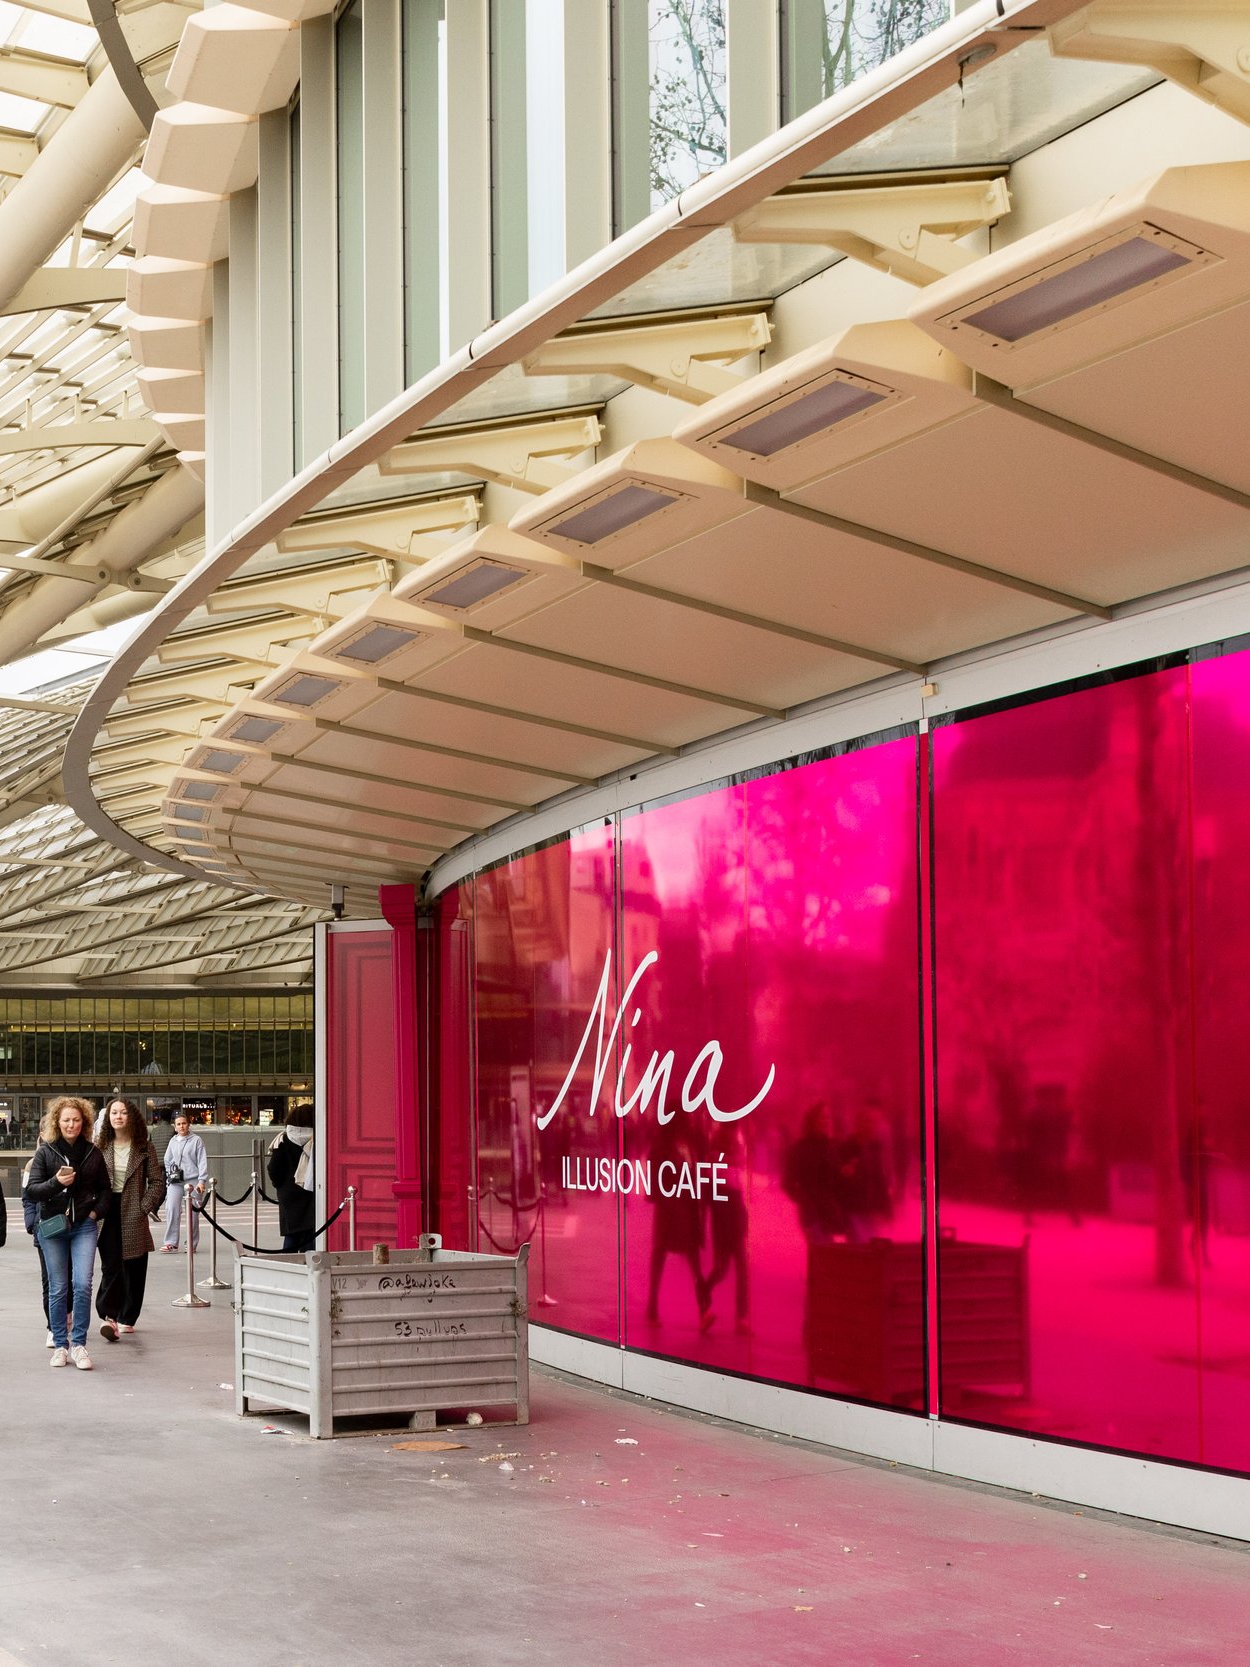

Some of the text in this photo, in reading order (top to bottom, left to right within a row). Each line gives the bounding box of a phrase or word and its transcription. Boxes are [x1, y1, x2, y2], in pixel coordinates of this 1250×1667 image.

[537, 948, 775, 1130] Nina
[562, 1152, 729, 1202] ILLUSION CAFÉ
[394, 1321, 412, 1337] 53
